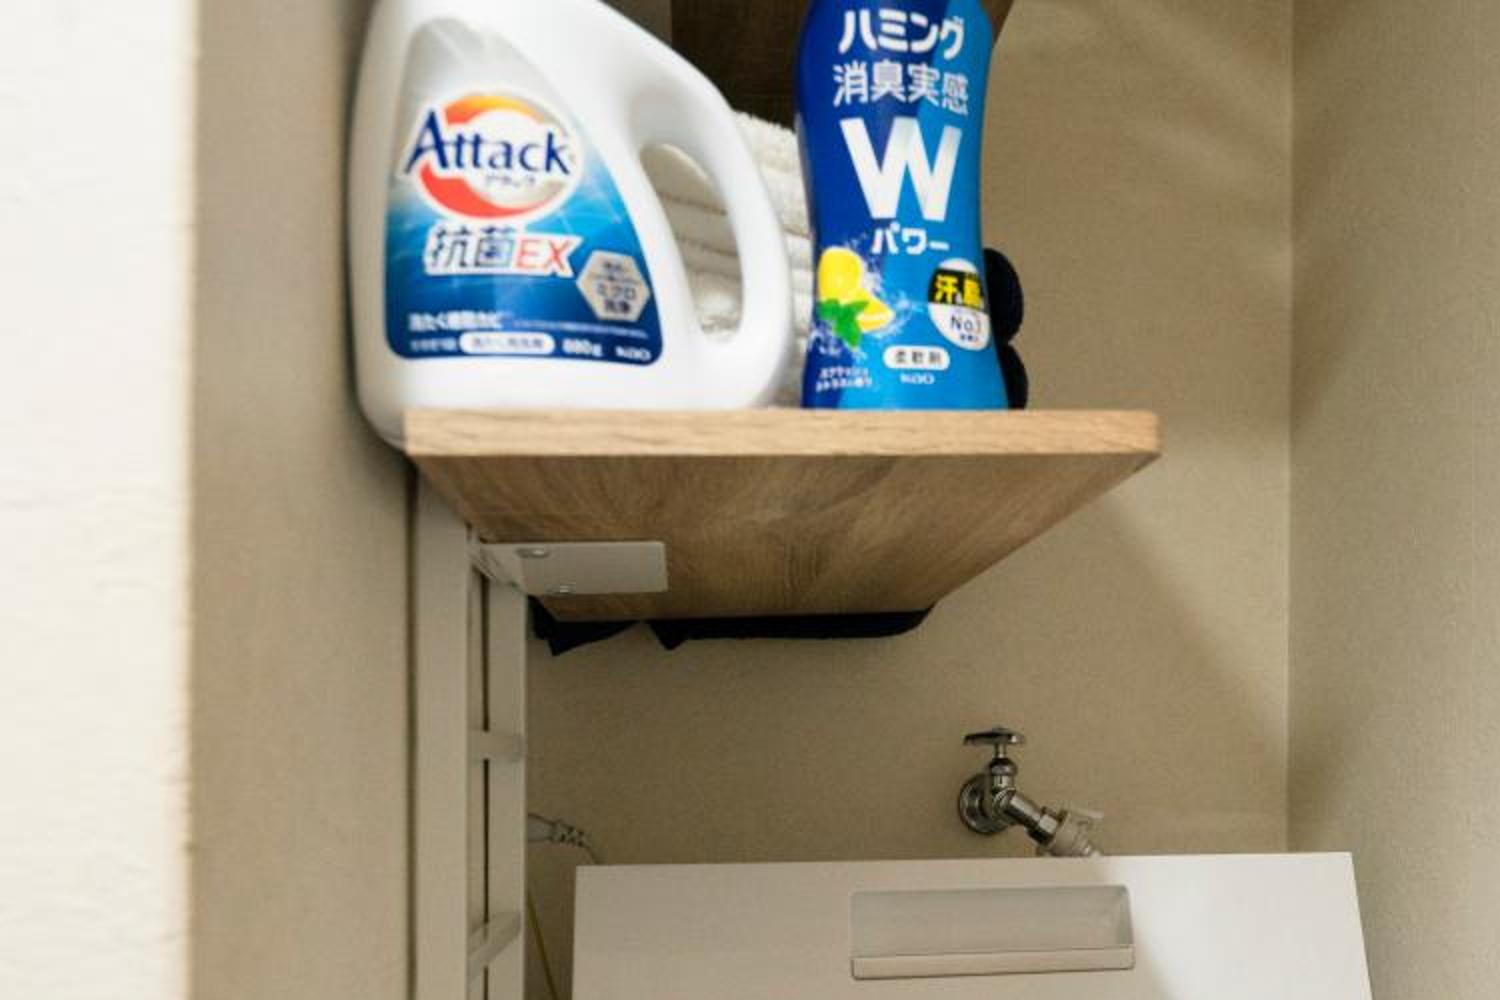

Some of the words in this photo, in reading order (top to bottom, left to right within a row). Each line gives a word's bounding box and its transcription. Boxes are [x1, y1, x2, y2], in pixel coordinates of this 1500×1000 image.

[839, 9, 965, 61] ハミング
[832, 60, 969, 117] 消臭実感
[405, 109, 571, 176] Attack
[839, 116, 962, 222] W
[872, 224, 950, 255] パワー
